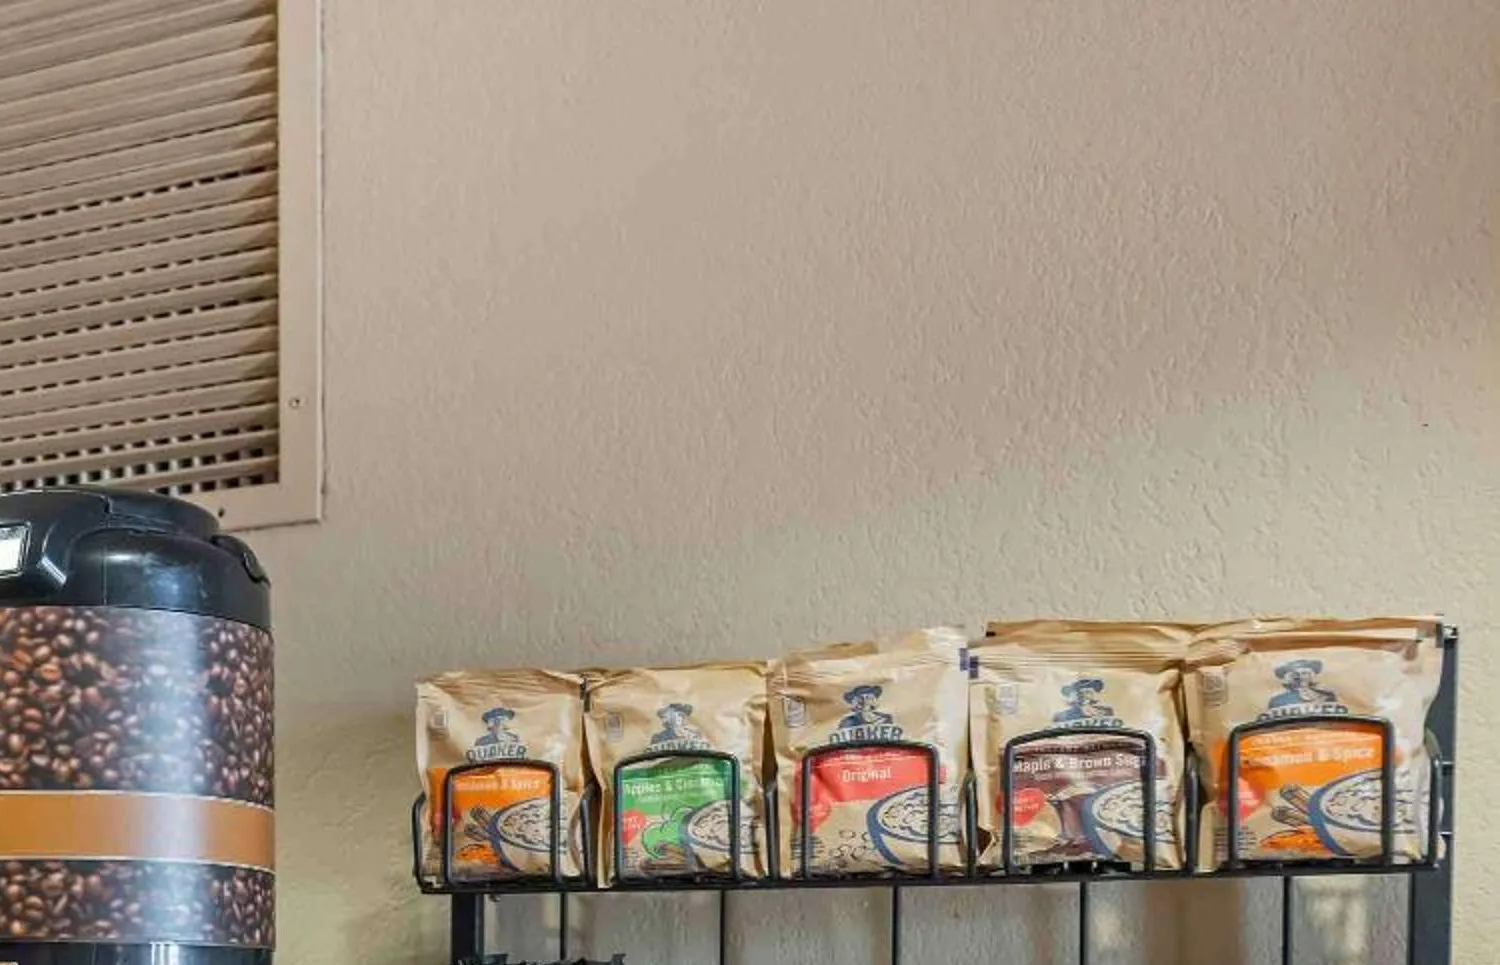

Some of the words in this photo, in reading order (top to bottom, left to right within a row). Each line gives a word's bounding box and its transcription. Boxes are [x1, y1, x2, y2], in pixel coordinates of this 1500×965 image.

[829, 725, 904, 743] QUAKER
[465, 744, 528, 765] QUAKER
[1068, 754, 1112, 769] Brown
[842, 767, 893, 784] Original
